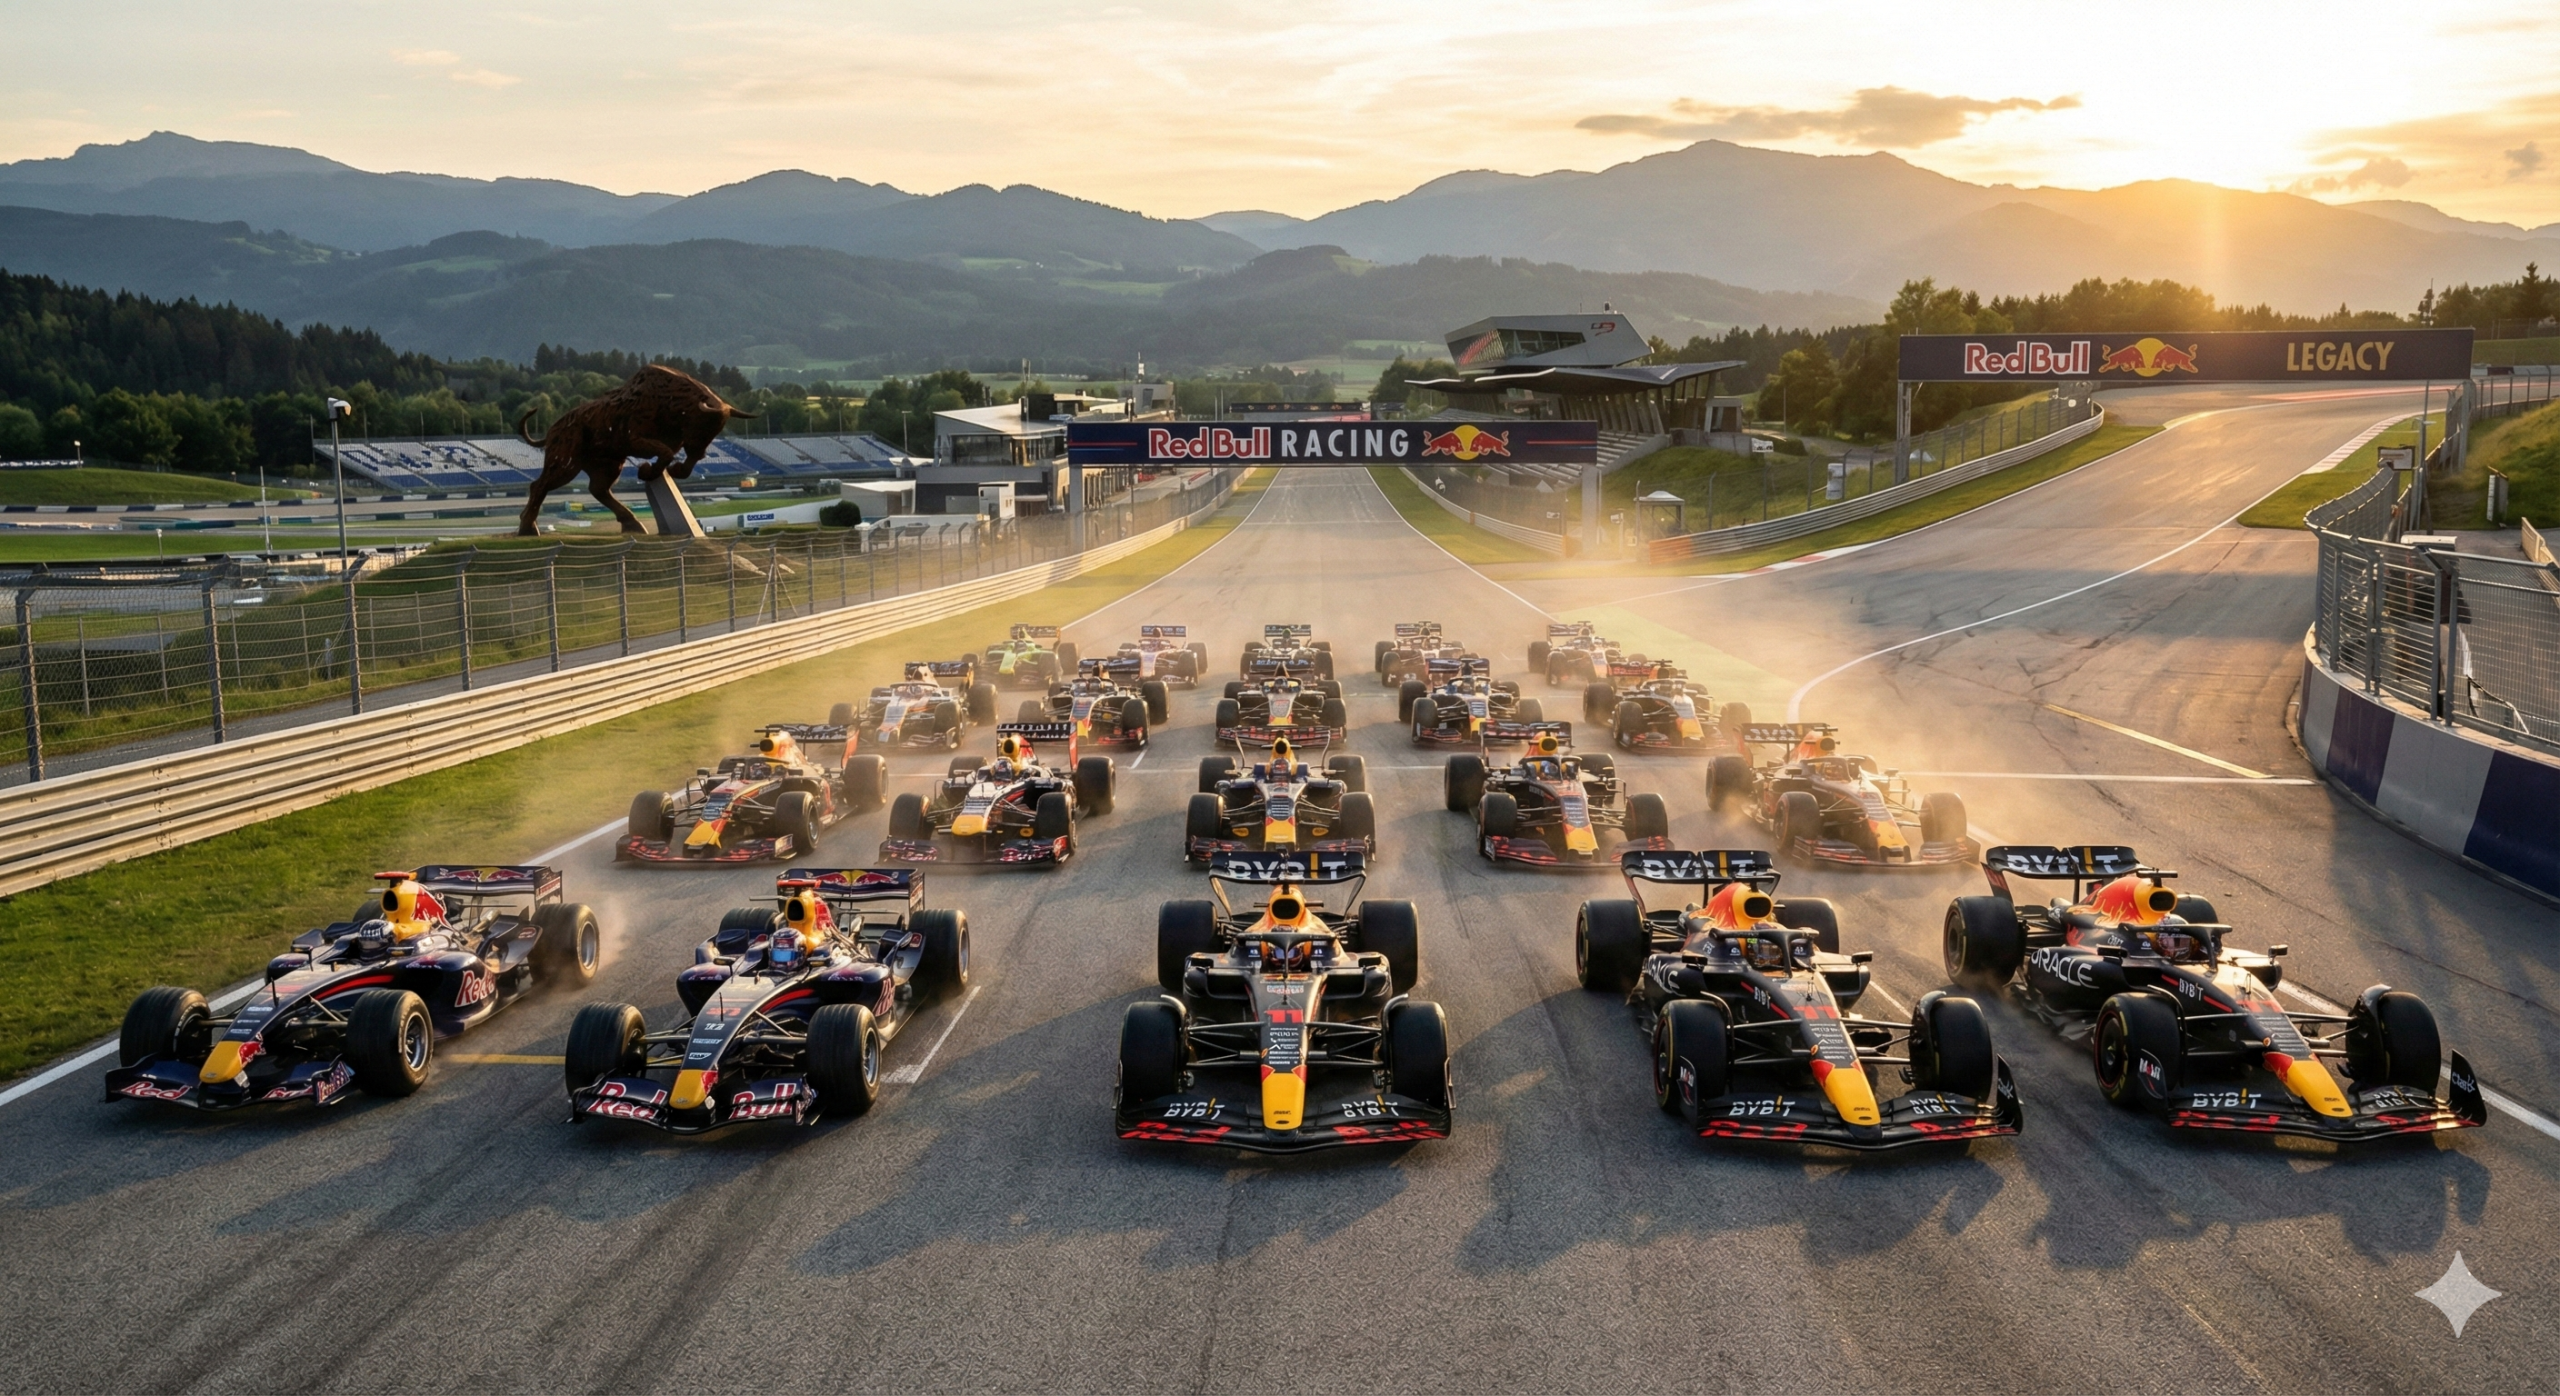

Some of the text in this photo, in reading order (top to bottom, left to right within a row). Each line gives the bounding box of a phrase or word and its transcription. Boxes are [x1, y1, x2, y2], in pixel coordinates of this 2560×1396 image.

[1964, 341, 2091, 375] Red Bull
[2287, 341, 2395, 372] LEGACY
[1148, 426, 1409, 459] Red Bull RACING
[2031, 947, 2099, 989] ORACLE
[1265, 1009, 1304, 1023] 11
[121, 1081, 192, 1099] Red
